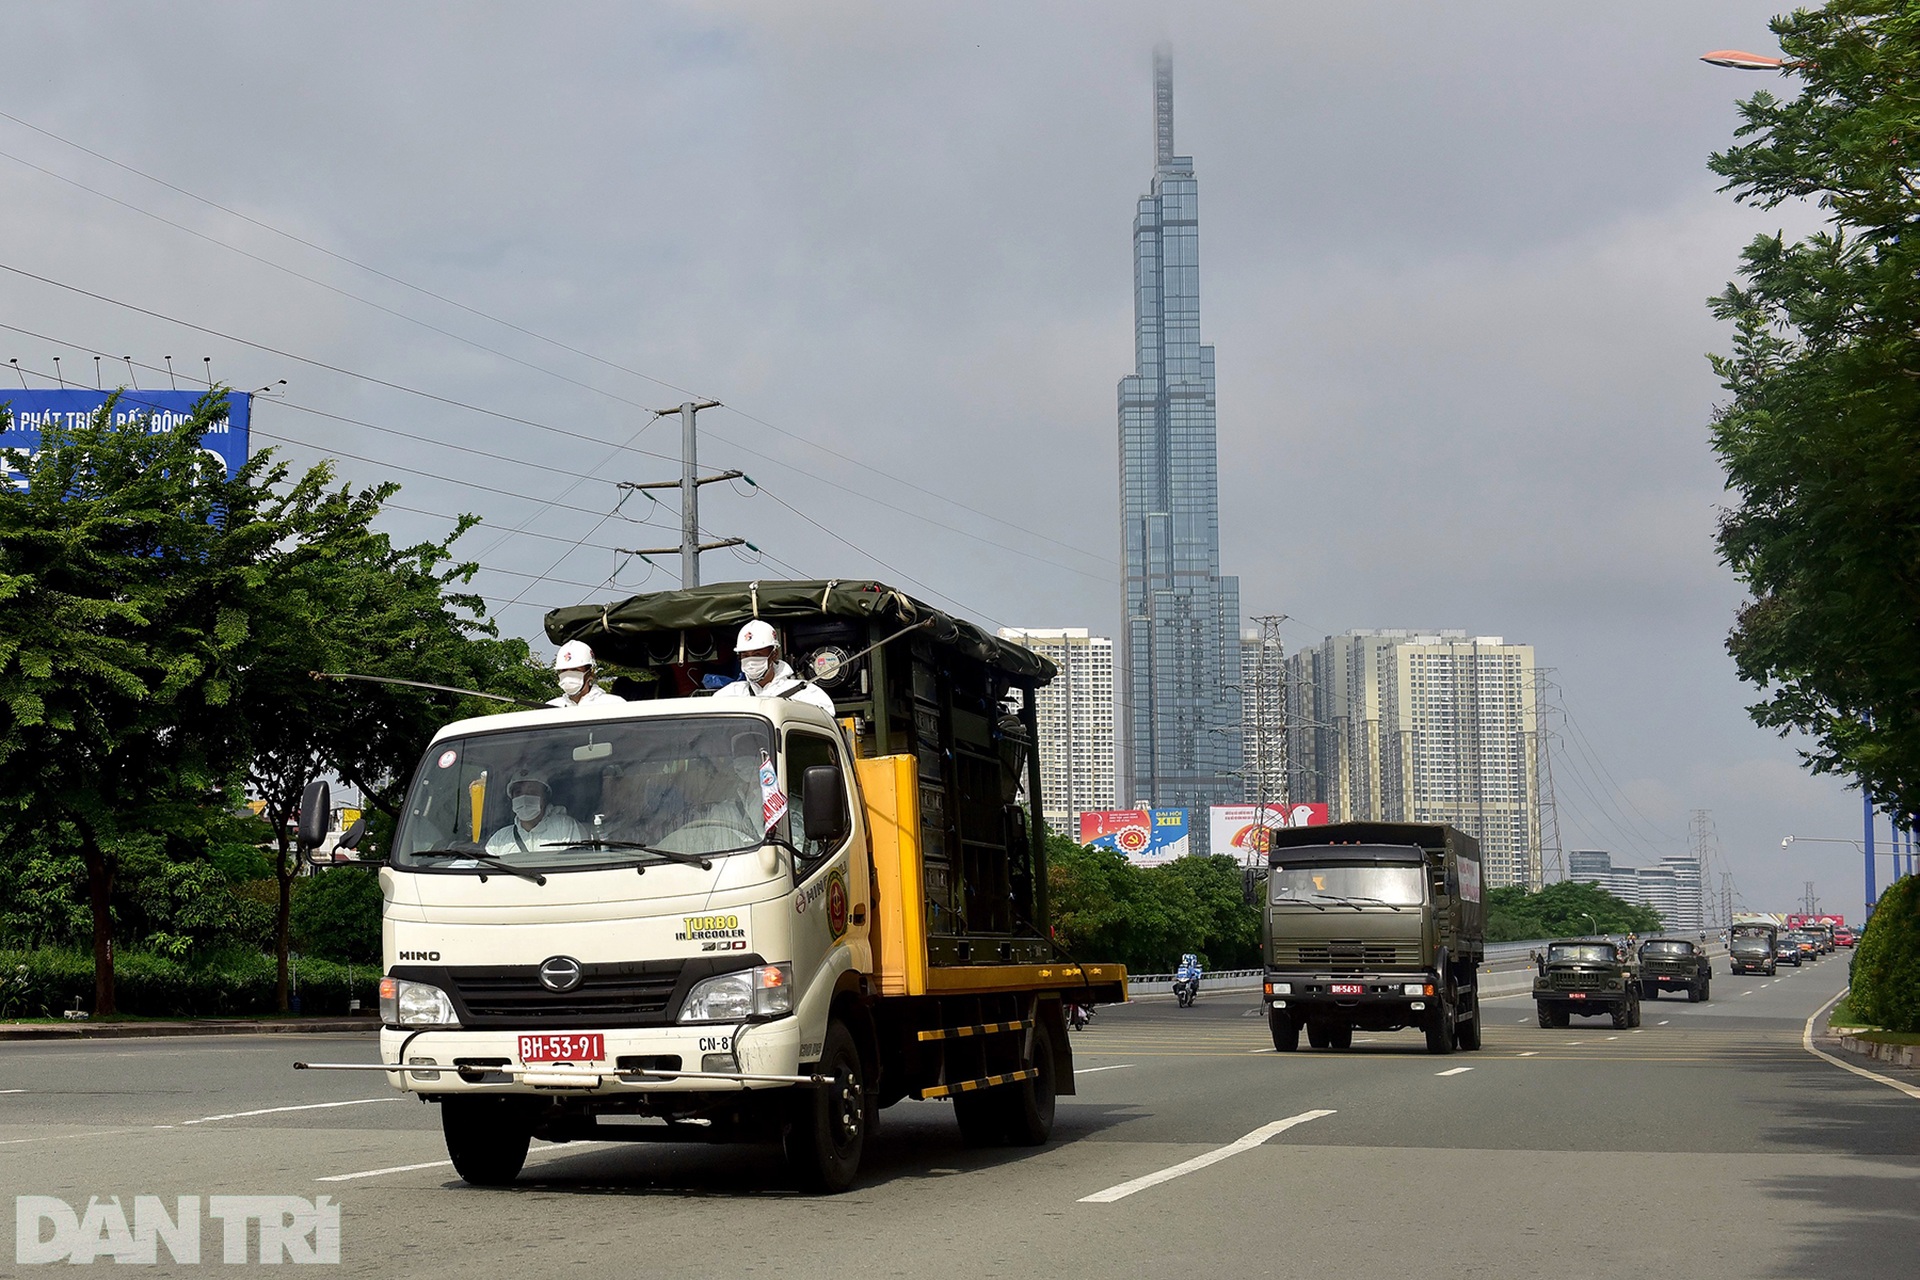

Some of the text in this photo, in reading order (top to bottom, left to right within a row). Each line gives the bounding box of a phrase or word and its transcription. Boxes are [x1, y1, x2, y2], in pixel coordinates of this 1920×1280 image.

[20, 409, 62, 431] PHÁT
[1156, 817, 1182, 827] XIII
[683, 915, 738, 940] TURBO
[702, 941, 746, 951] 300
[400, 951, 440, 961] HINO
[521, 1036, 598, 1058] BH-53-91
